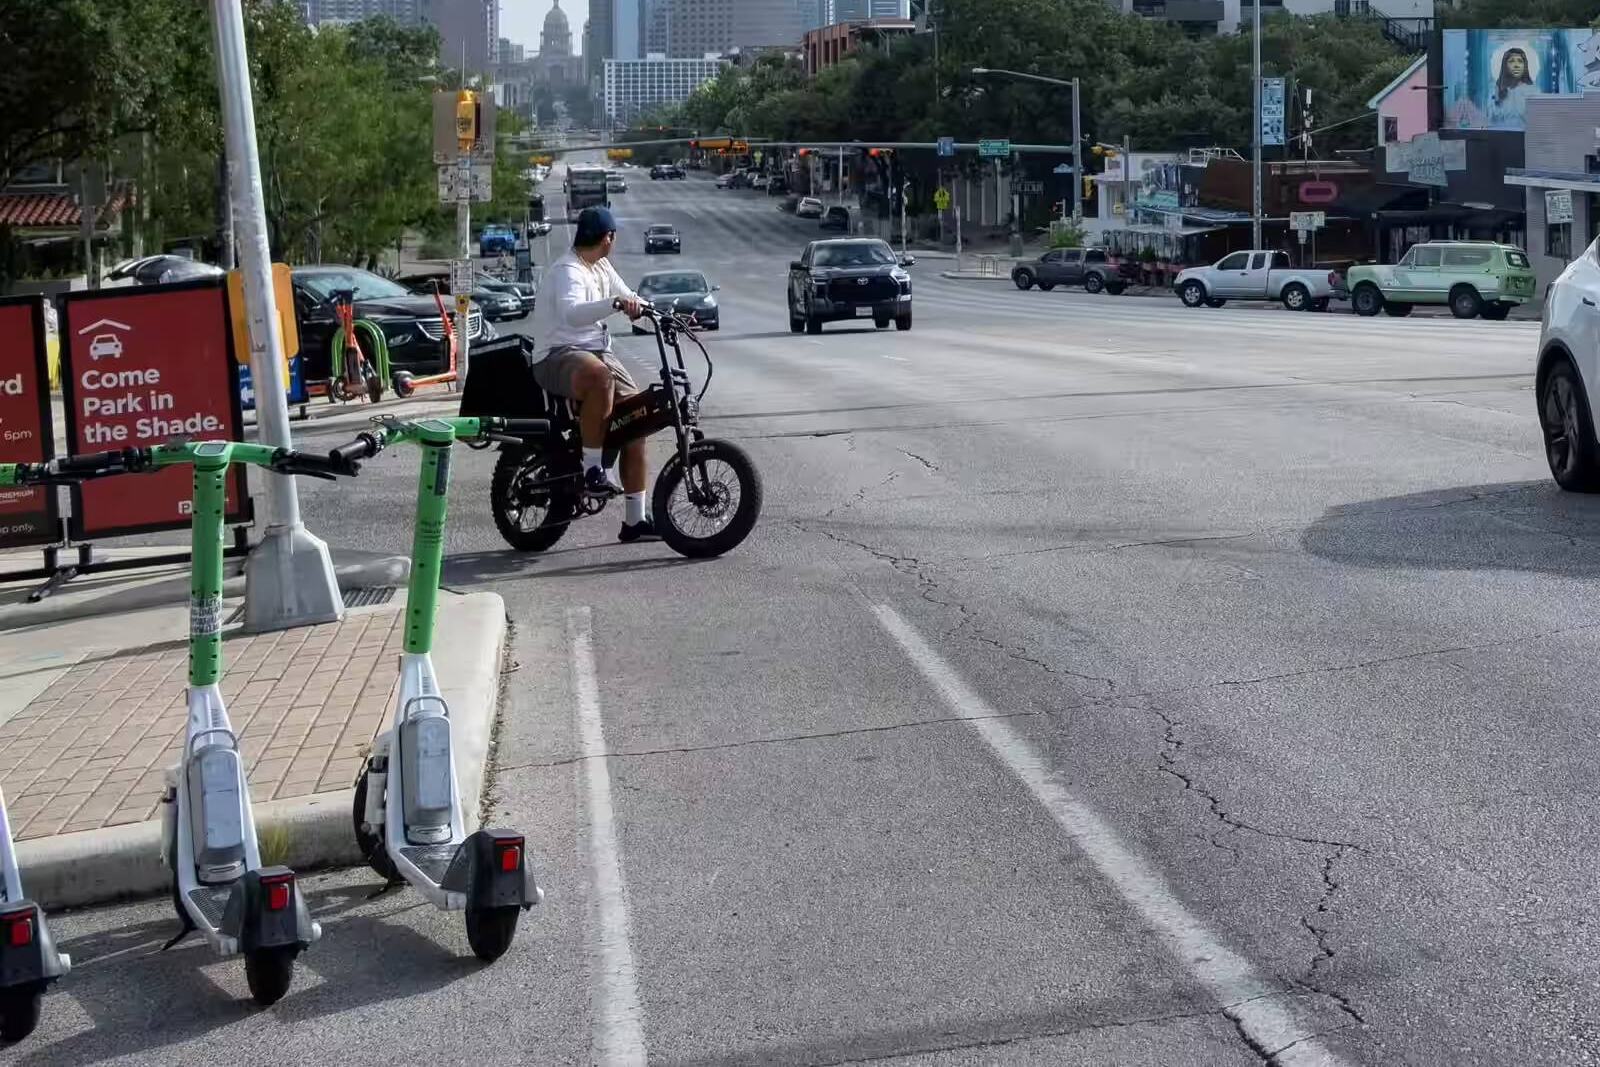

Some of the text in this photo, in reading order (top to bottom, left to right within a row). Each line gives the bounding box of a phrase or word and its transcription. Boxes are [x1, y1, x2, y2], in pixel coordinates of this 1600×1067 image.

[82, 368, 160, 390] Come
[83, 391, 174, 417] Park in
[85, 412, 225, 444] the Shade.
